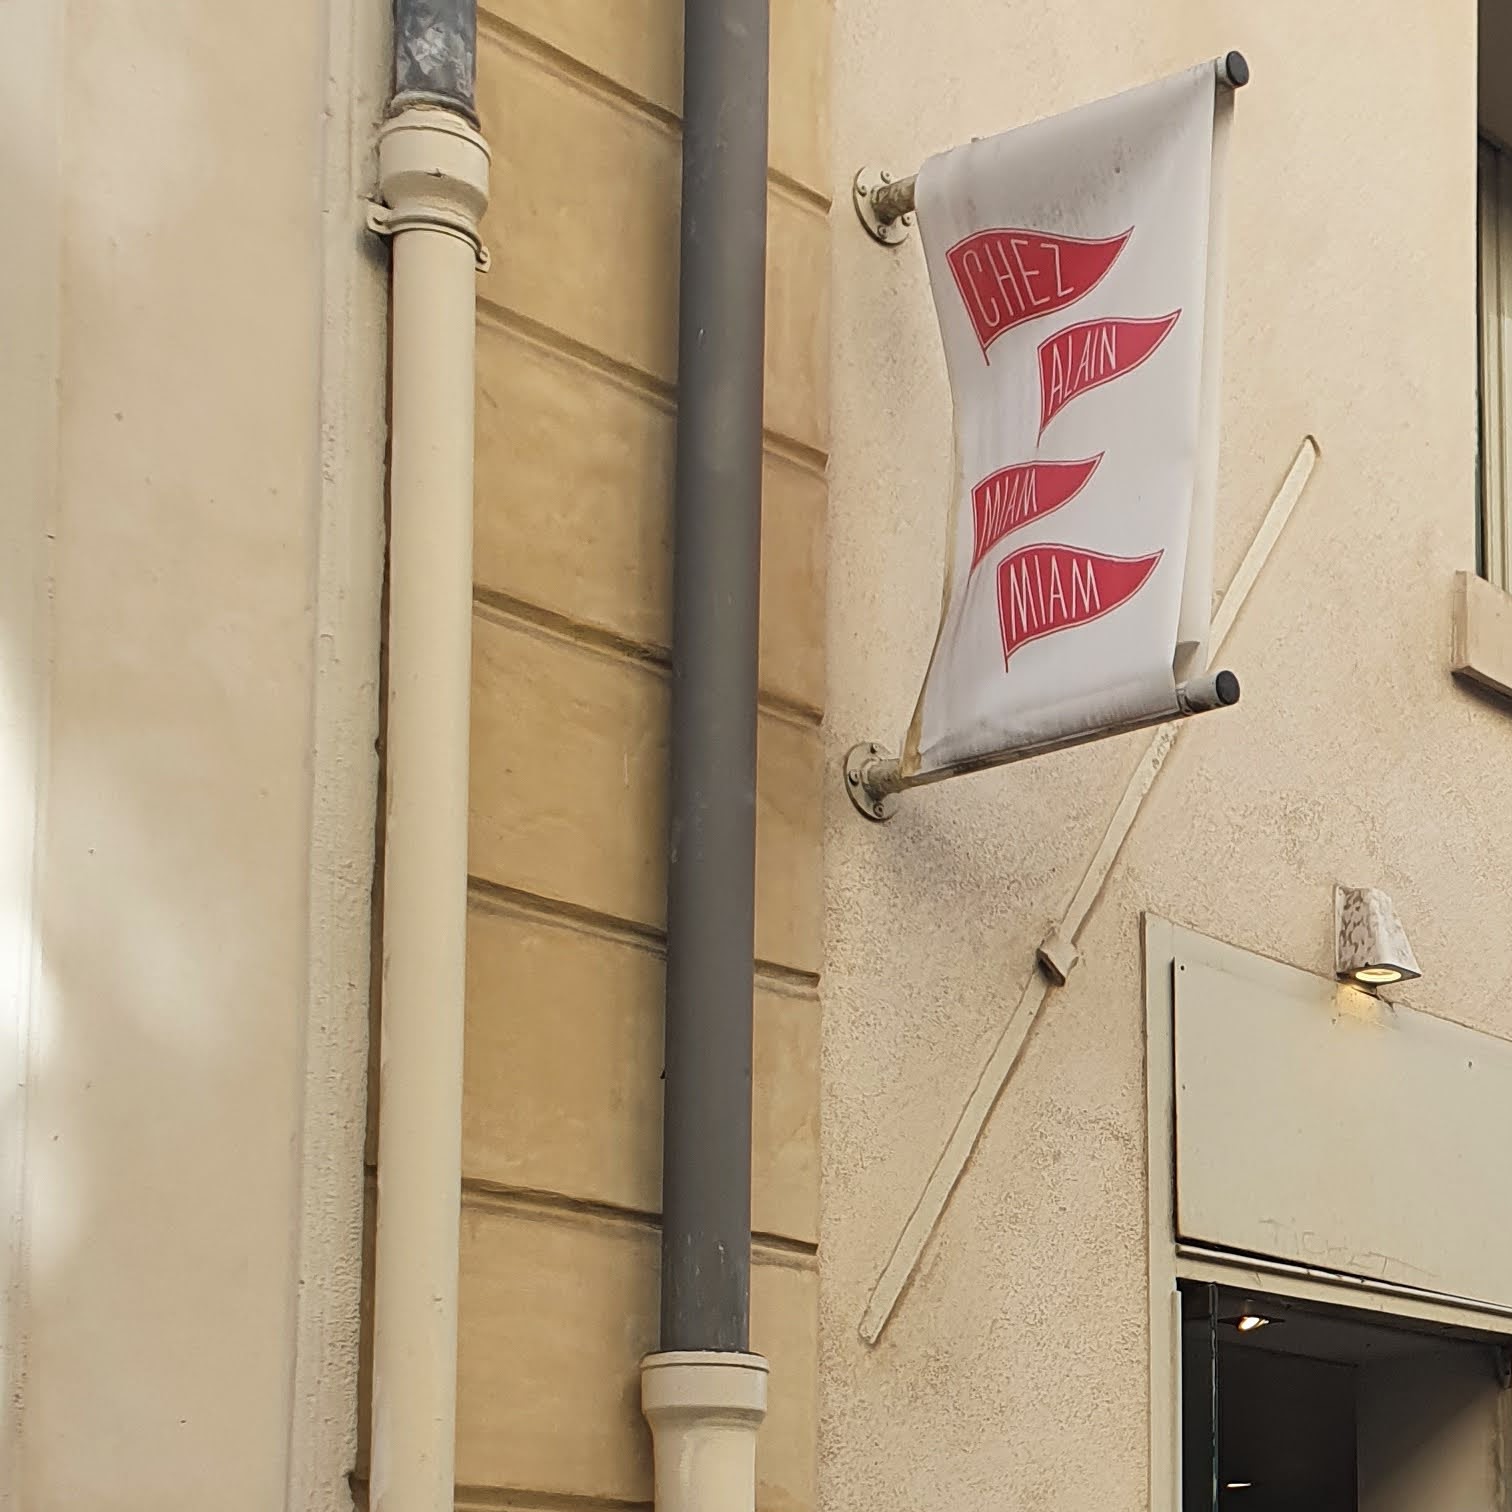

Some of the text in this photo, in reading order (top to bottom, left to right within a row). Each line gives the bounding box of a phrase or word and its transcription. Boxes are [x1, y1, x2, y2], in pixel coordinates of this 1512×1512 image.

[962, 238, 1075, 327] CHEZ
[1046, 324, 1118, 417] ALAIN
[977, 467, 1038, 560] MIAM
[1009, 554, 1102, 642] MIAM
